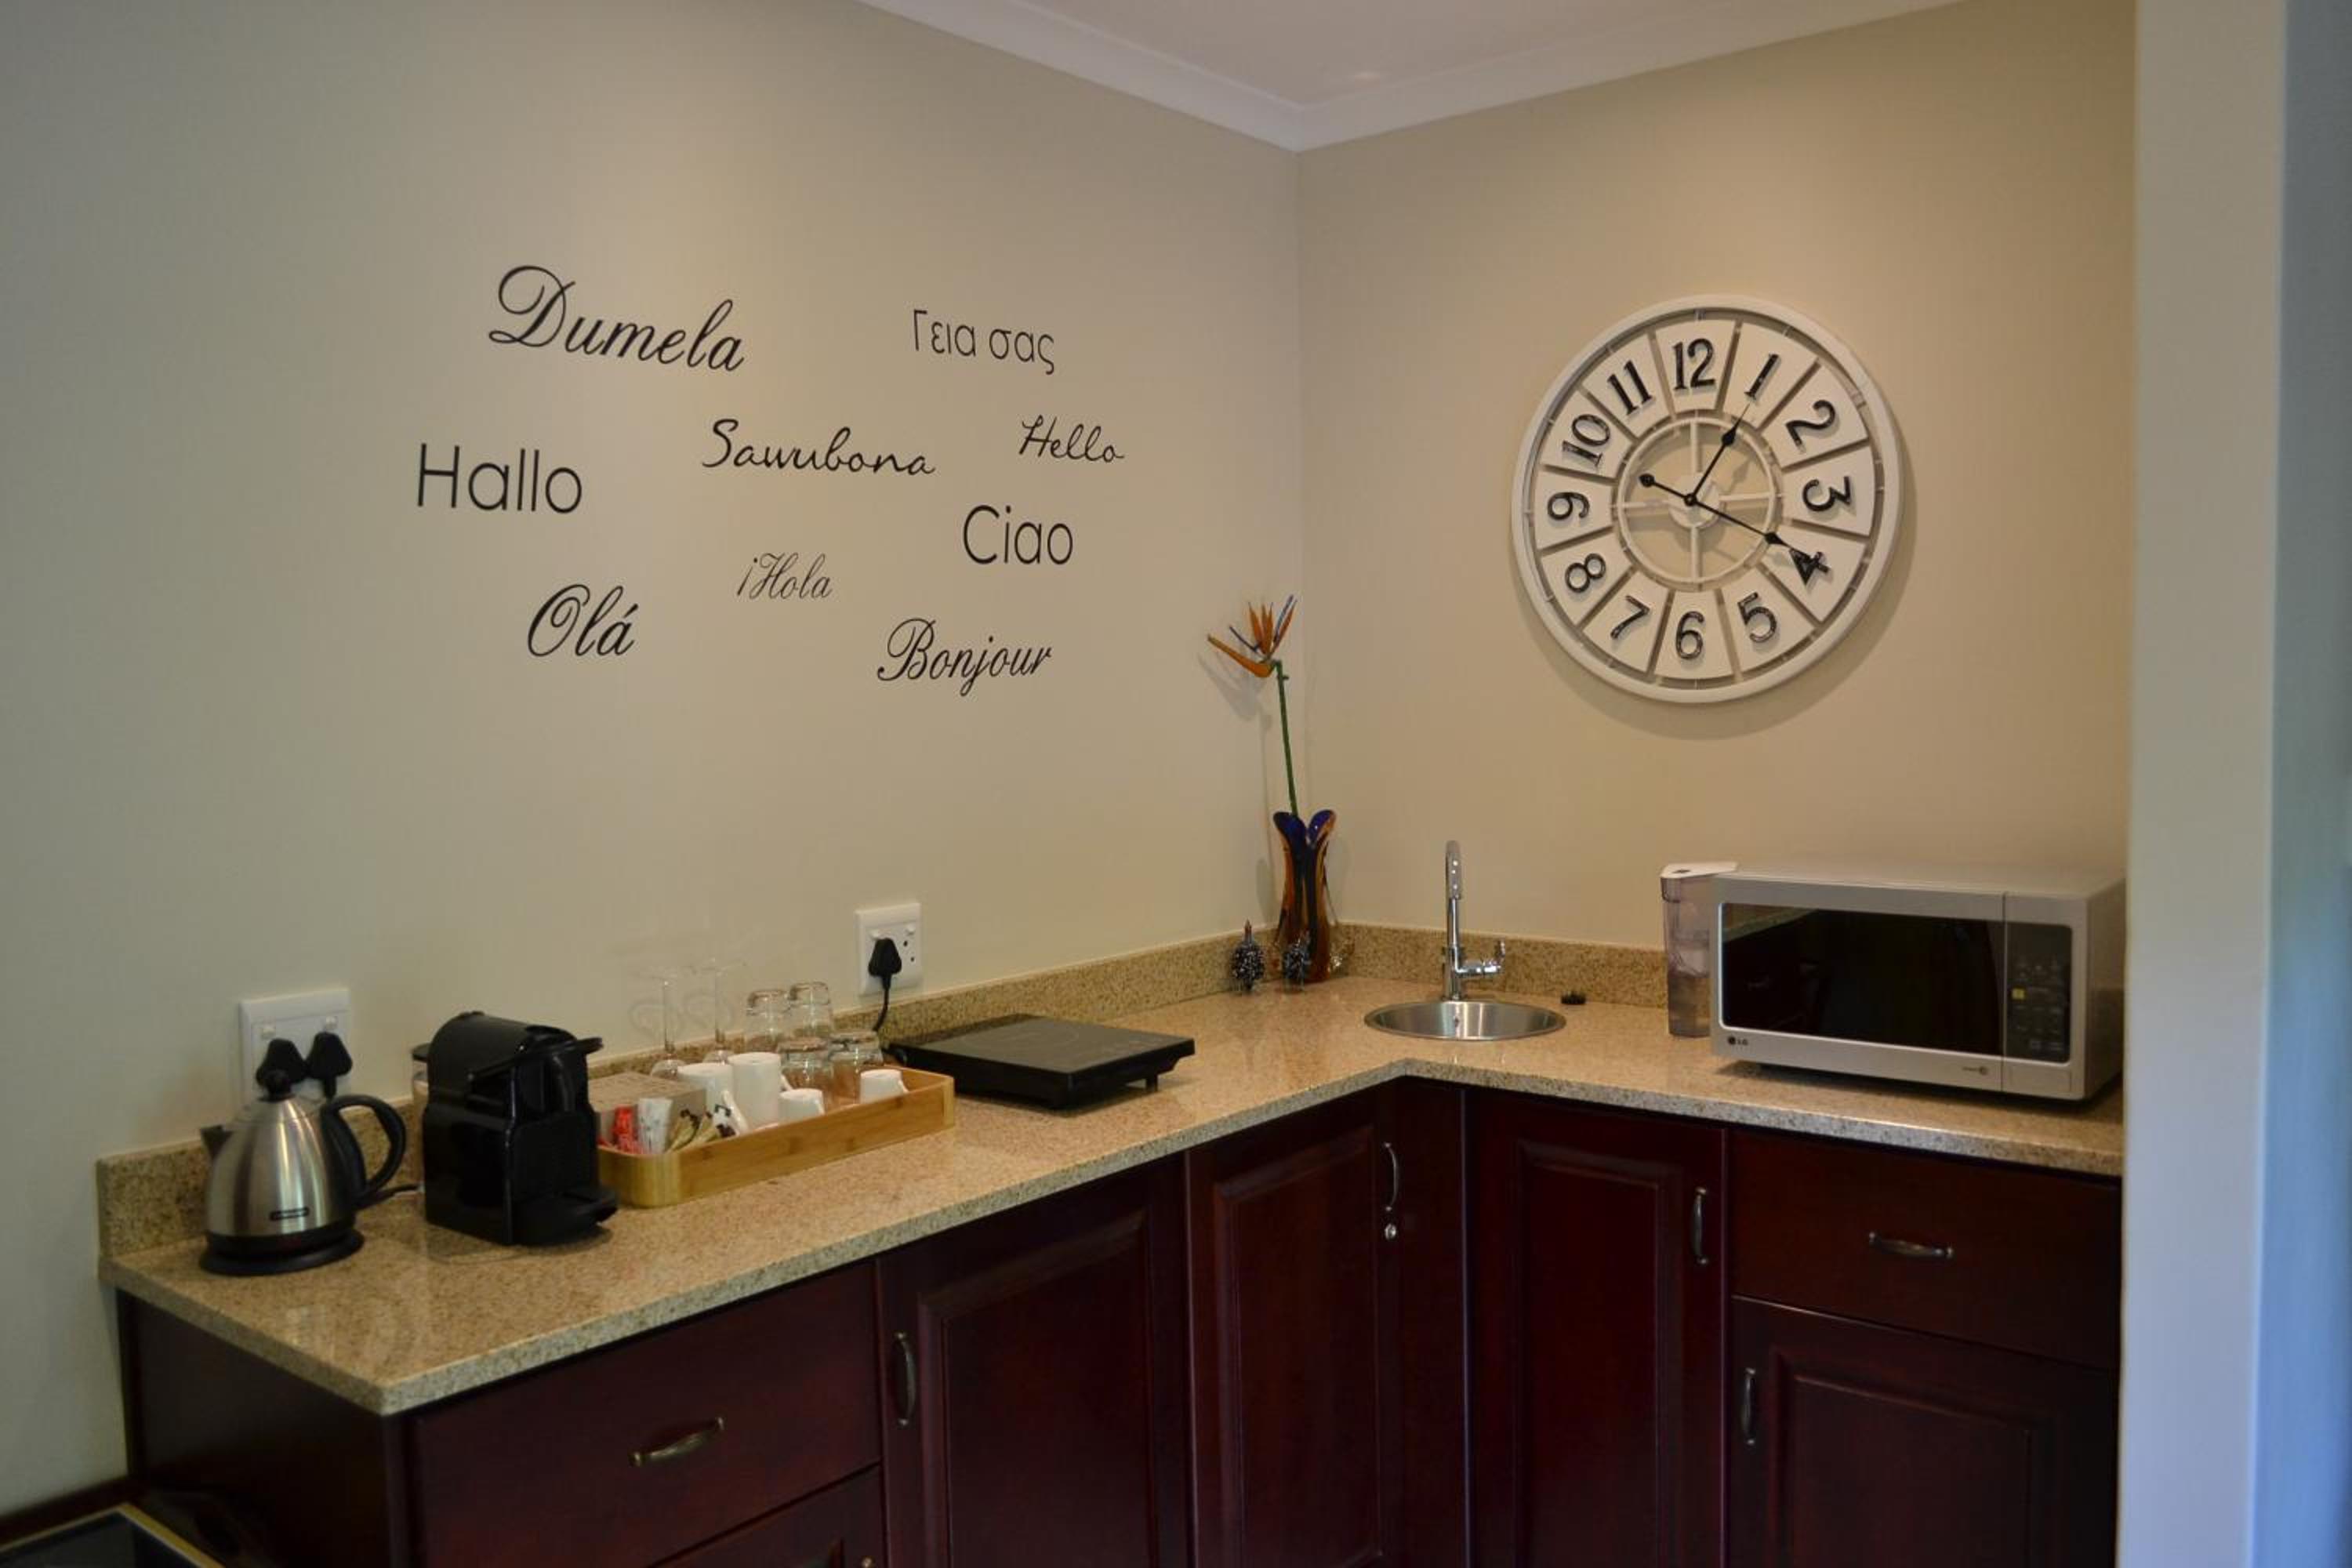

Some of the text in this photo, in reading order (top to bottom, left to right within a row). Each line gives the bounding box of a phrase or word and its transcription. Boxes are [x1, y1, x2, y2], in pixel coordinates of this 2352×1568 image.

[488, 264, 745, 372] Dumela
[913, 308, 1055, 376] Γεια σας
[1606, 359, 1654, 416] 11
[1672, 338, 1716, 392] 12
[1744, 354, 1780, 400] 1
[702, 418, 937, 477] Sawubona
[1018, 414, 1126, 464] Hello
[1562, 412, 1612, 468] 10
[1786, 398, 1837, 452] 2
[416, 442, 583, 515] Hallo
[1802, 476, 1853, 514] 3
[1547, 491, 1591, 521] 9
[962, 504, 1073, 566] Ciao
[1564, 552, 1608, 594] 8
[1788, 549, 1831, 586] 4
[527, 583, 639, 658] Olá
[1610, 594, 1651, 641] 7
[1675, 610, 1706, 661] 6
[1737, 592, 1778, 644] 5
[876, 617, 1052, 698] Bonjour
